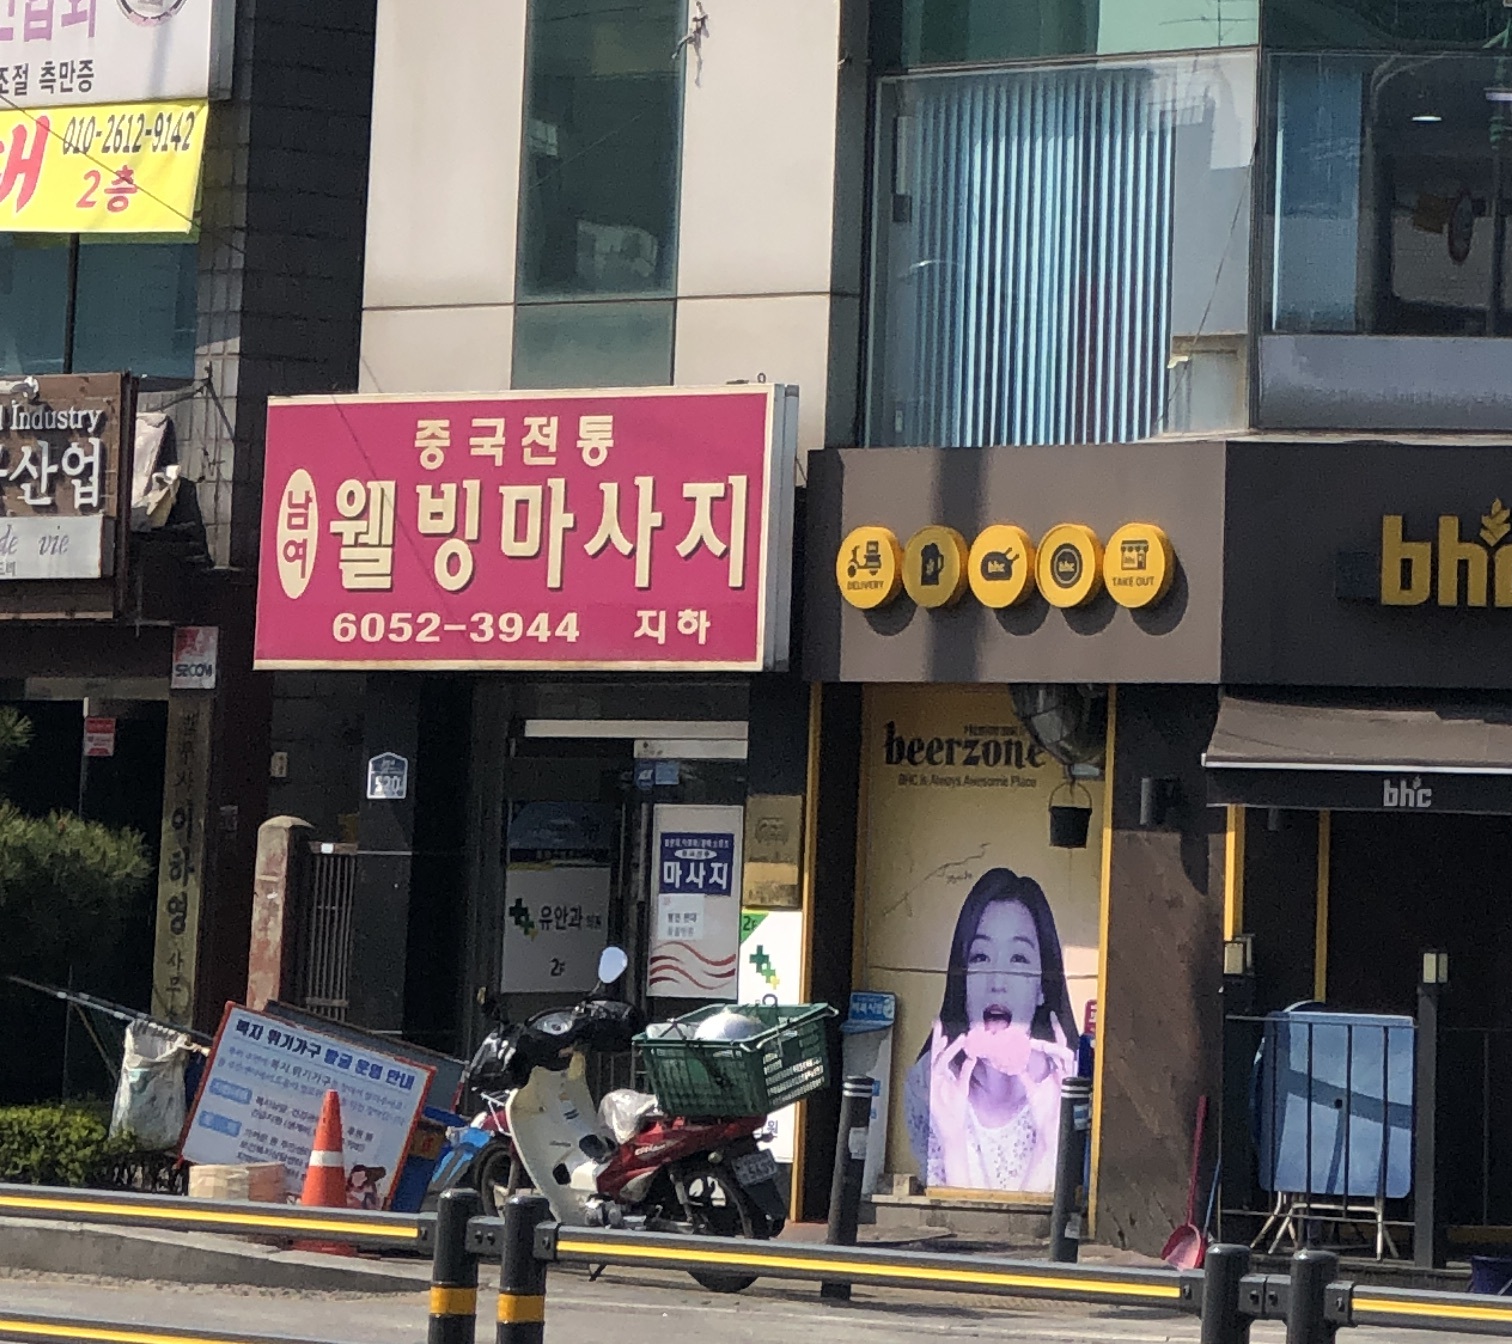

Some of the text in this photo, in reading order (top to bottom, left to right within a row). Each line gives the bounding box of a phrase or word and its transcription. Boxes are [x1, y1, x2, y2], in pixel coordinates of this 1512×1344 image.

[38, 58, 95, 97] 측만증
[62, 111, 196, 157] 010-2612-9142
[76, 165, 138, 213] 2층
[10, 407, 104, 439] Industry
[413, 414, 615, 470] 중국전통
[0, 438, 101, 511] 산업
[39, 525, 71, 556] vie
[282, 489, 313, 580] 남여
[329, 474, 748, 591] 웰빙마사지
[332, 611, 580, 643] 6052-3944
[633, 608, 712, 645] 지하
[884, 720, 1047, 770] beerzone
[1382, 778, 1433, 809] bhc
[662, 860, 731, 891] 마사지
